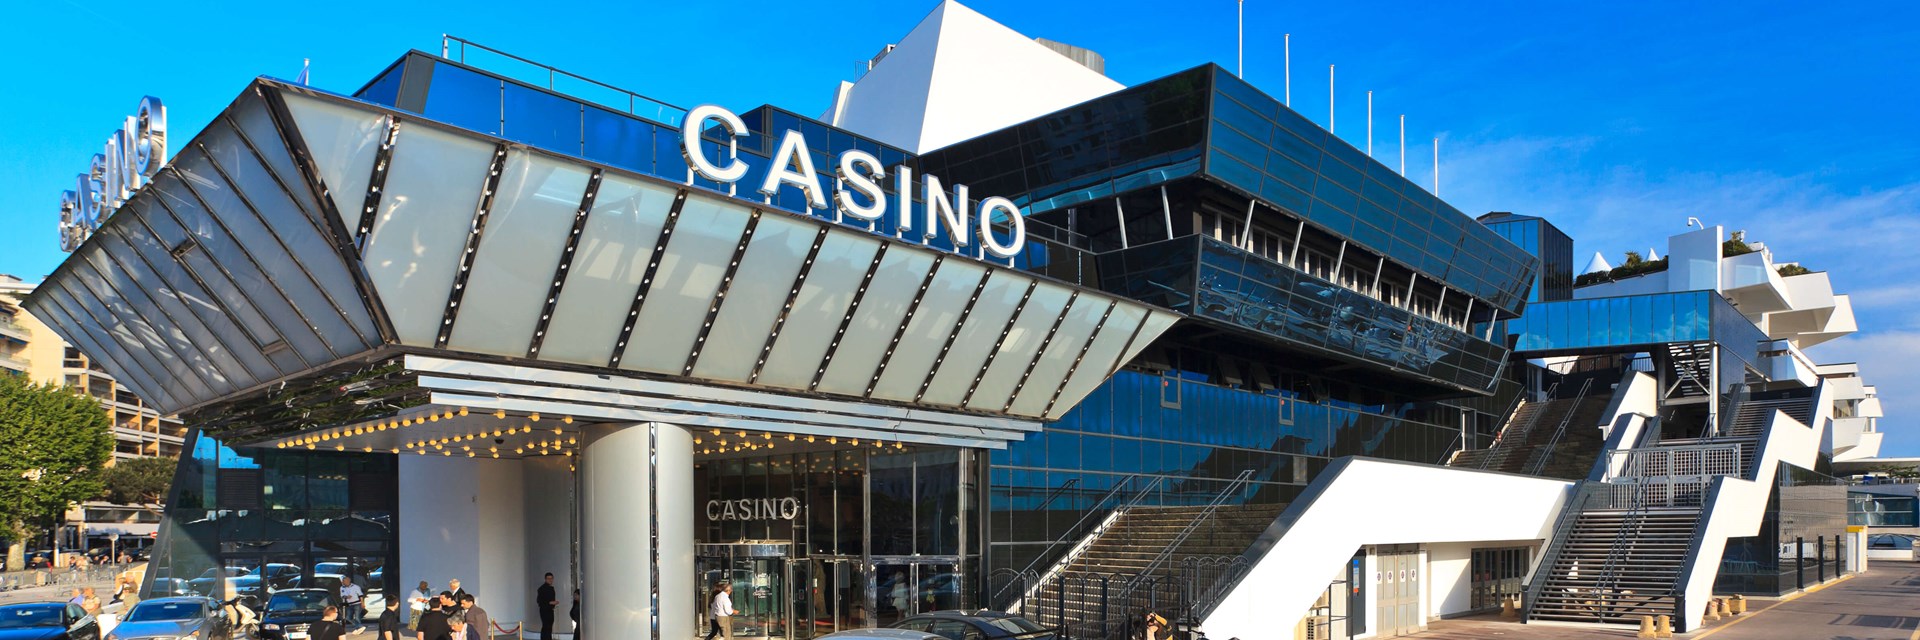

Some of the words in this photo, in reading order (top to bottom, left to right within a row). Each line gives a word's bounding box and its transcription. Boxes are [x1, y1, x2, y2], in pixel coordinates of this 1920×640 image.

[58, 95, 164, 252] CASINO
[680, 104, 1026, 259] CASINO
[706, 497, 797, 521] CASINO
